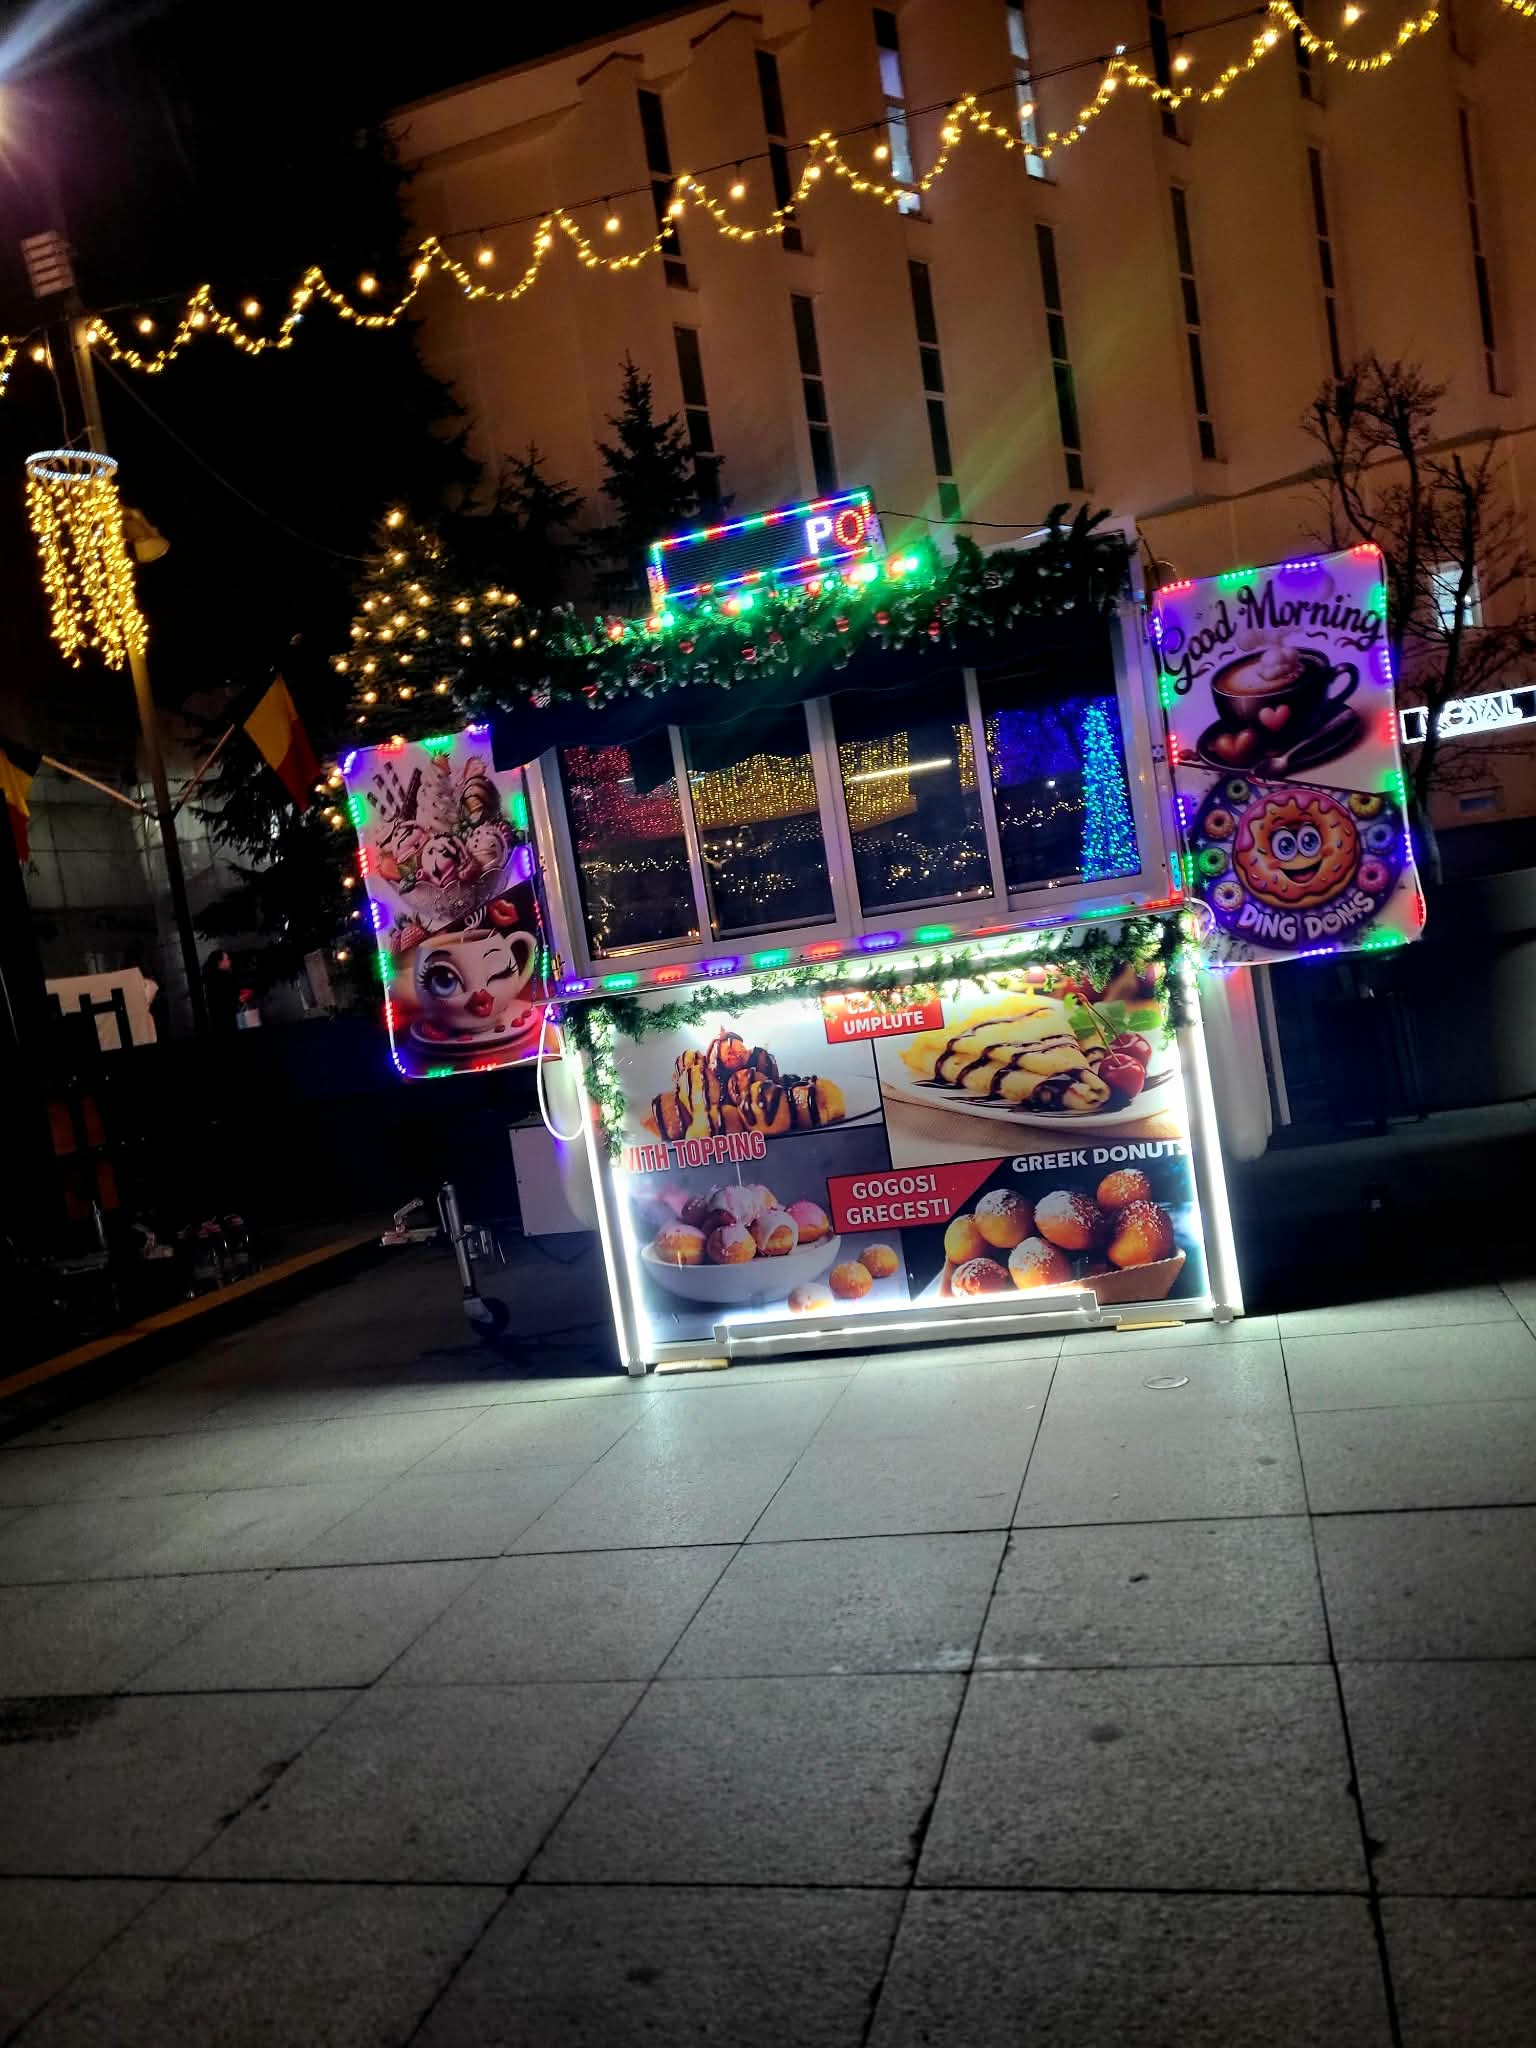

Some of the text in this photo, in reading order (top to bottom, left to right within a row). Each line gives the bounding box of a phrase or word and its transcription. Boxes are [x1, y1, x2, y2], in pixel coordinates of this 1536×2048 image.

[806, 509, 865, 554] PO
[1159, 579, 1385, 695] Good Morning
[1238, 903, 1296, 942] DING
[843, 1010, 925, 1035] UMPLUTE
[672, 1131, 766, 1169] TOPPING
[1012, 1150, 1088, 1173] GREEK
[852, 1174, 937, 1200] GOGOSI
[846, 1198, 950, 1225] GRECESTI
